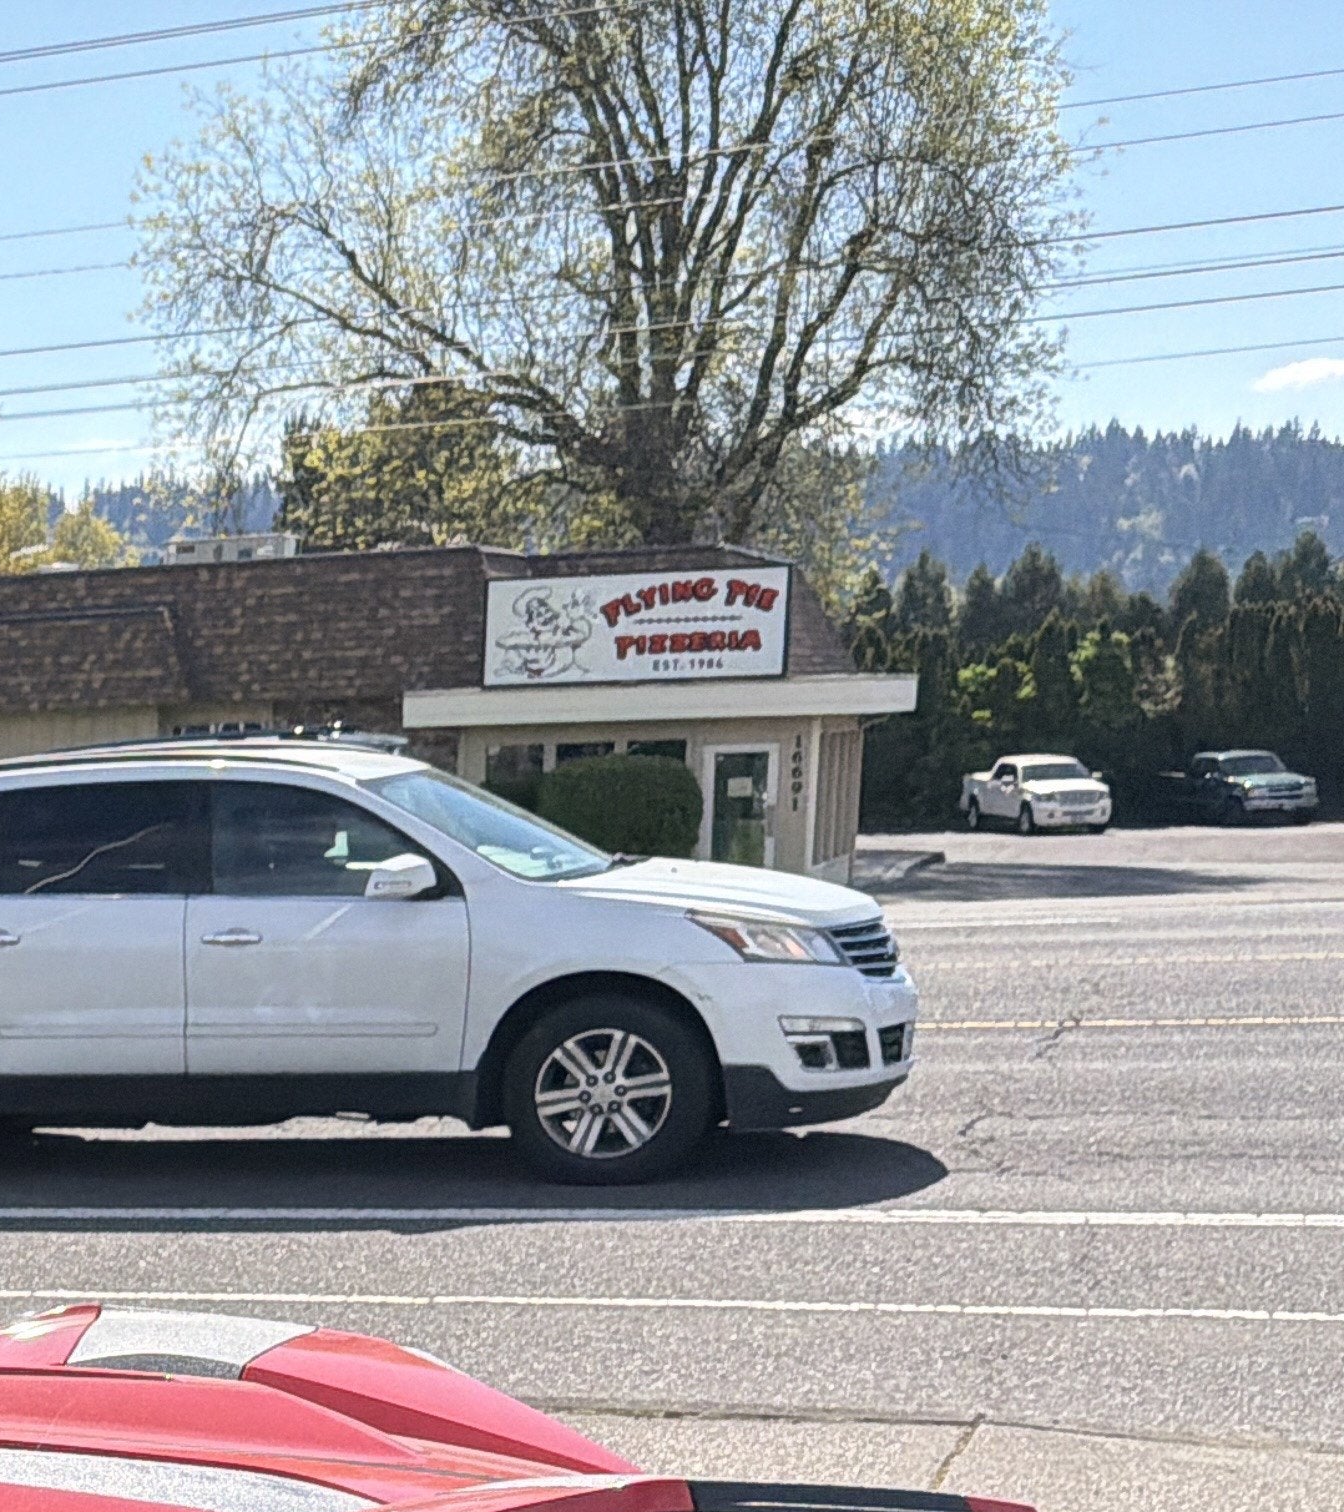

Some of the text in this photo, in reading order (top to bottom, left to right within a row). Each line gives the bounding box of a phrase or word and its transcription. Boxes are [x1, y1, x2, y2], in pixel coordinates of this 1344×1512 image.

[600, 577, 780, 628] FLYING PIE
[614, 629, 762, 660] PIZZERIA
[652, 659, 684, 671] EST.
